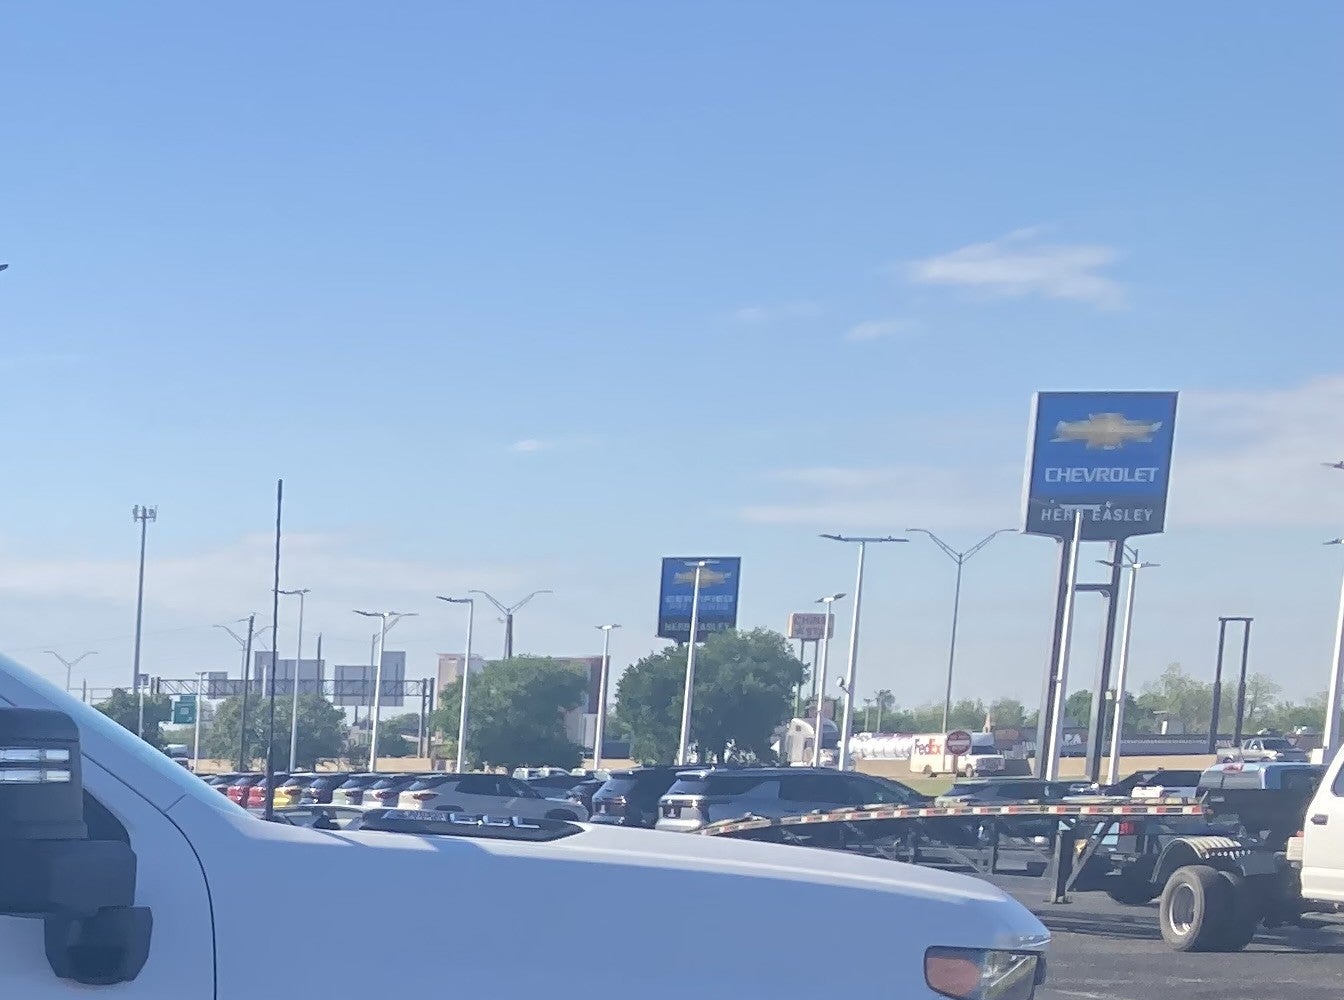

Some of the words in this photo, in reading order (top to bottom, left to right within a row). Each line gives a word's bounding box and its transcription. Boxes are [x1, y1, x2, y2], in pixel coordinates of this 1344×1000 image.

[1044, 467, 1159, 483] CHEVROLET
[1092, 507, 1153, 521] EASLEY
[914, 738, 942, 756] FedEx
